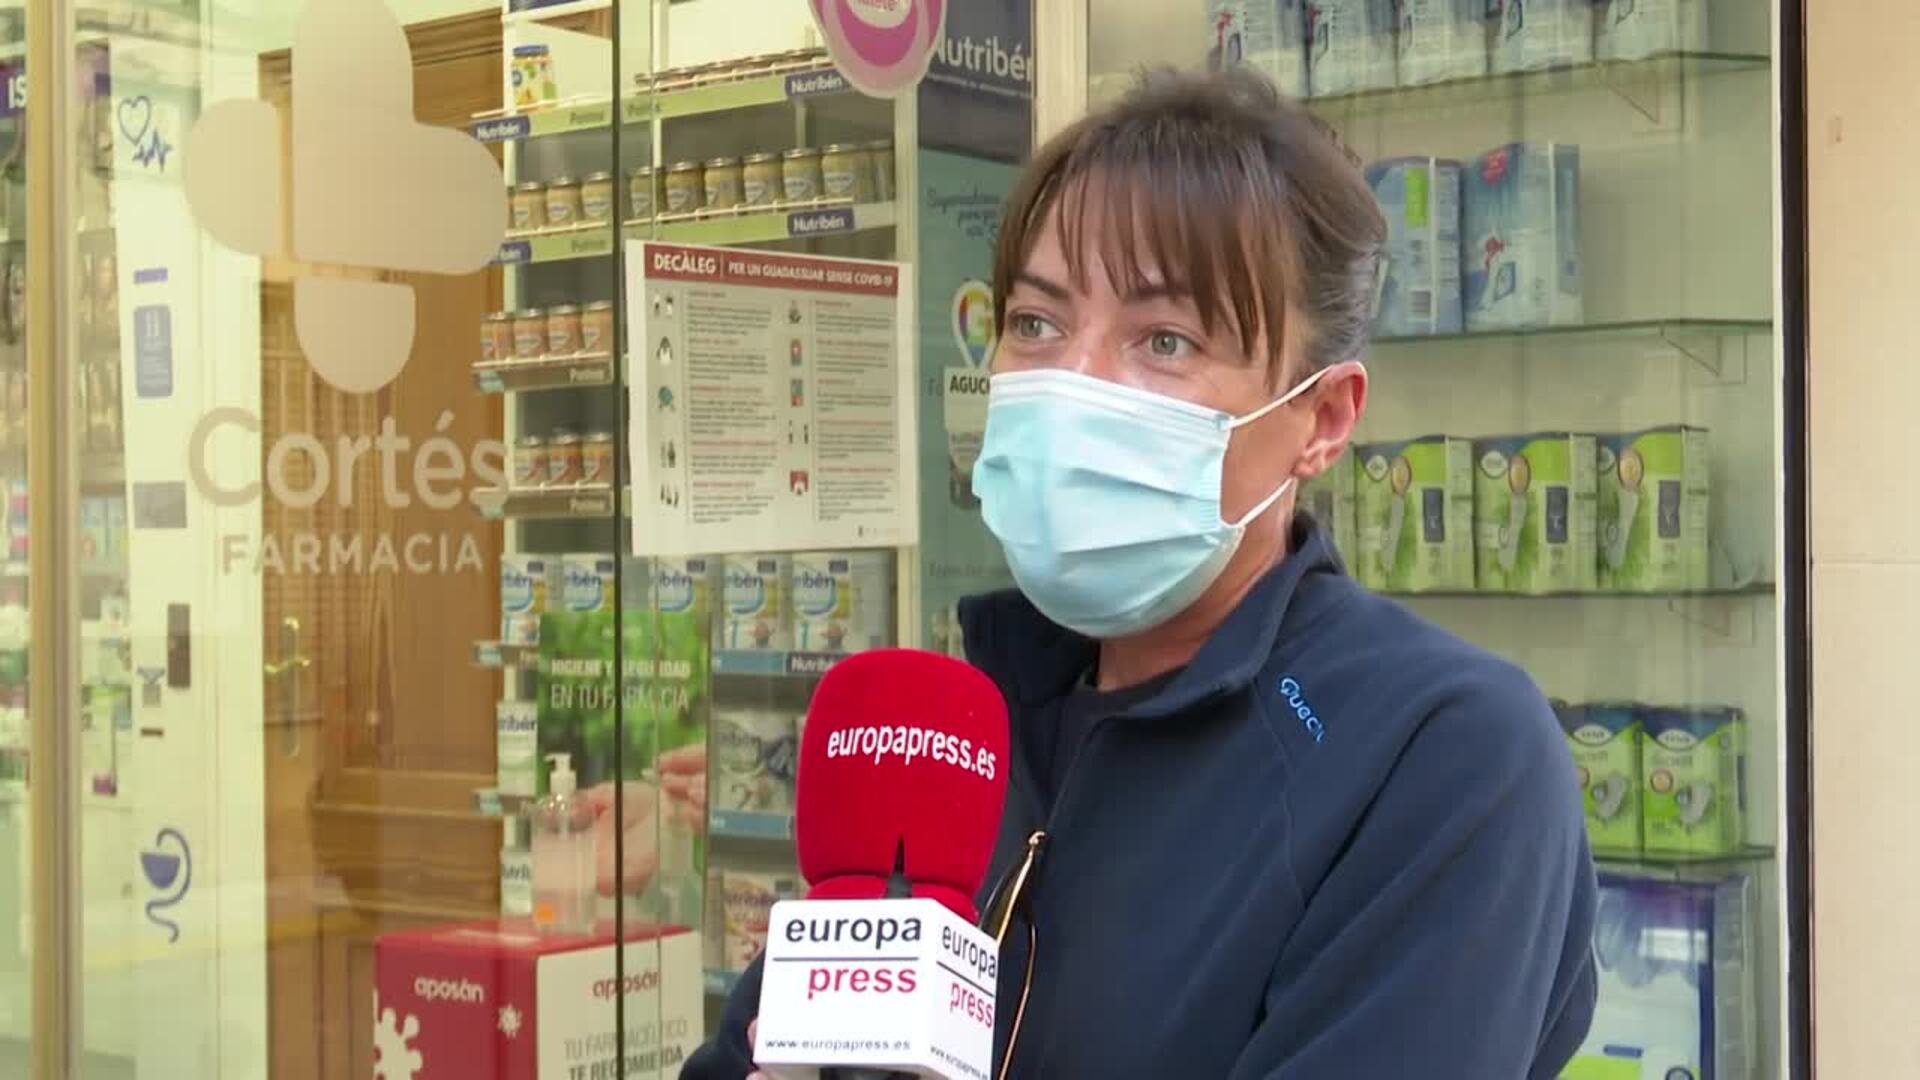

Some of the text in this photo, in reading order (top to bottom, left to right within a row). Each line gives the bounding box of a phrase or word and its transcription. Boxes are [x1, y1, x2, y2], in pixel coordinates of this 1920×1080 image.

[791, 73, 843, 94] Nutribén
[793, 215, 845, 233] Nutribén
[653, 252, 717, 274] DECÀLEG
[728, 262, 745, 276] PER
[747, 264, 761, 277] UN
[189, 407, 510, 509] Cortés
[222, 533, 484, 576] FARMACIA
[551, 684, 690, 711] EN TU FARMCIA
[827, 724, 997, 781] europapress.es
[785, 917, 922, 950] europa
[942, 924, 997, 980] europa
[414, 977, 485, 1004] aposán
[807, 968, 917, 1001] press
[949, 982, 994, 1029] press
[563, 1037, 582, 1061] TU
[765, 1038, 911, 1053] www.europapress.es
